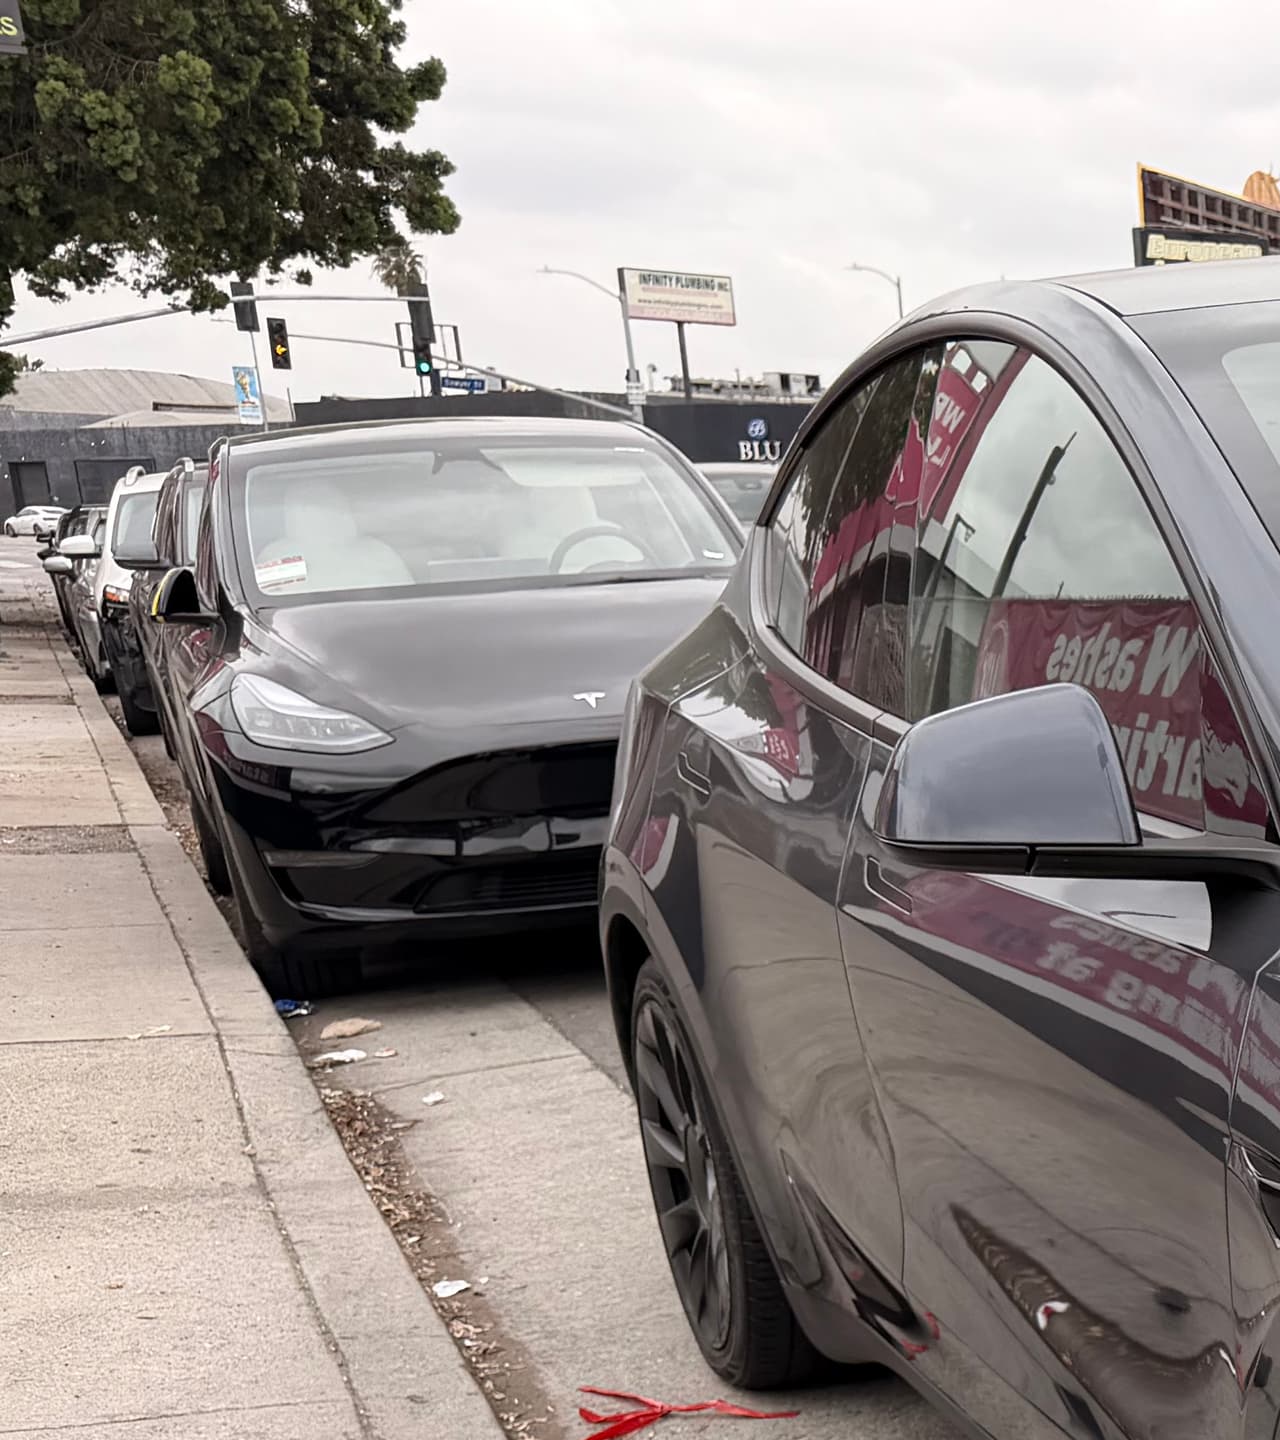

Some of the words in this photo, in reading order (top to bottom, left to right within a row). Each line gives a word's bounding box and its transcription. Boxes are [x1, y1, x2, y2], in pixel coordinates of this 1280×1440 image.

[0, 16, 17, 36] S
[638, 273, 674, 286] INFINITY
[675, 276, 716, 291] PLUMBING
[738, 440, 781, 461] BLU
